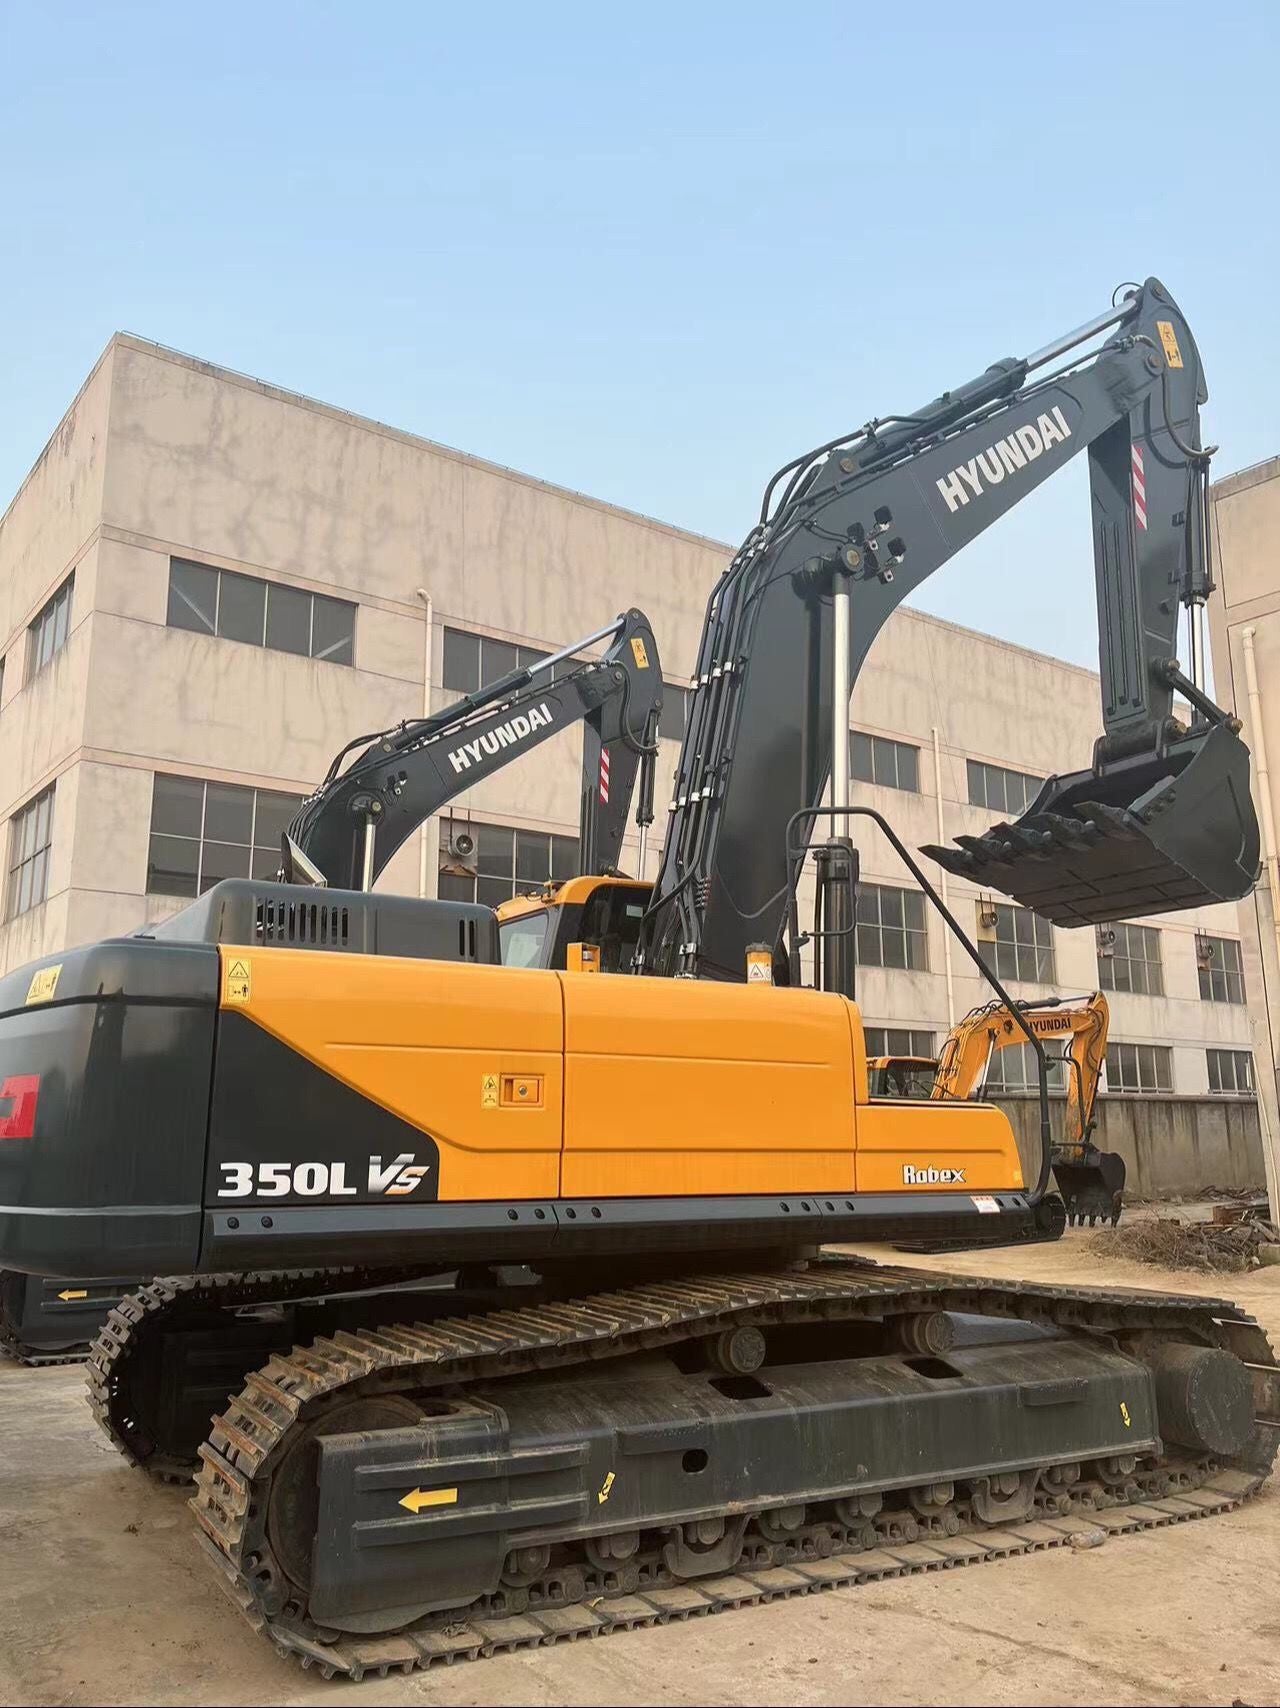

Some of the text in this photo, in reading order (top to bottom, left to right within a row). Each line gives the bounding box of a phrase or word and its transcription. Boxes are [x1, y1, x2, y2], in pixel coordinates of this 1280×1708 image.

[935, 405, 1072, 513] HYUNDAI
[448, 703, 553, 773] HYUNDAI
[217, 1162, 358, 1198] 350L
[902, 1164, 967, 1185] Robex
